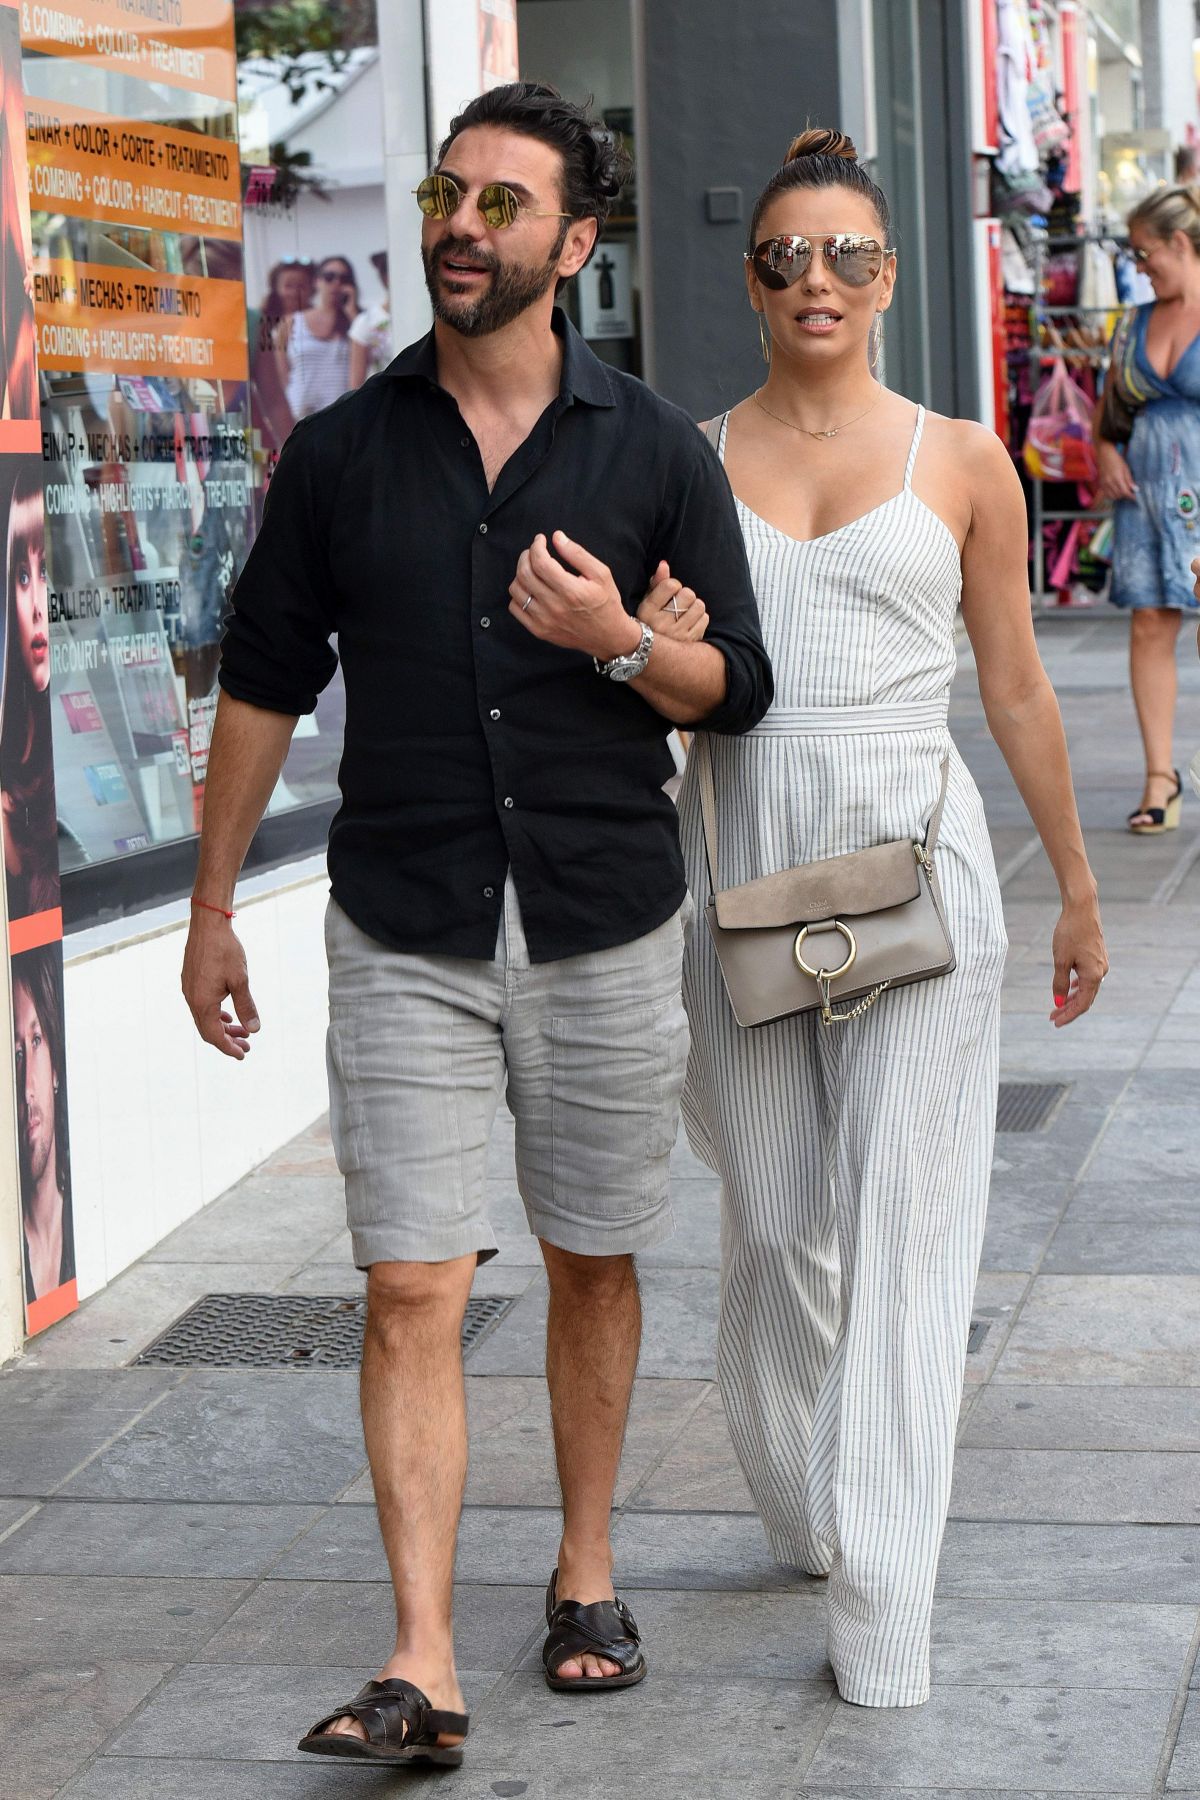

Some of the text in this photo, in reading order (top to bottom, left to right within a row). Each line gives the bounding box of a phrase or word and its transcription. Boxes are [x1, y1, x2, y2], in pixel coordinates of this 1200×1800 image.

[116, 0, 182, 26] AMIENTO
[22, 3, 31, 32] &
[33, 6, 85, 48] COMBING
[95, 24, 140, 63] COLOUR
[149, 39, 206, 80] TREATMENT
[25, 111, 62, 147] EINAR
[73, 123, 111, 157] COLOR
[121, 133, 156, 167] CORTE
[165, 143, 230, 181] TRATAMIENTO
[34, 164, 83, 202] COMBING
[92, 175, 135, 211] COLOUR
[142, 185, 182, 219] HAIRCUT
[80, 278, 124, 310] MECHAS
[134, 284, 201, 318] TRATAMIENTO
[42, 324, 90, 359] COMBING
[100, 329, 156, 362] HIGHLIGHTS
[88, 432, 131, 462] MECHAS
[100, 481, 153, 512] HIGHLIGHTS
[48, 589, 101, 623] BALLERO
[112, 581, 181, 614] TRATAMIENTO
[109, 630, 168, 666] TREATMENT
